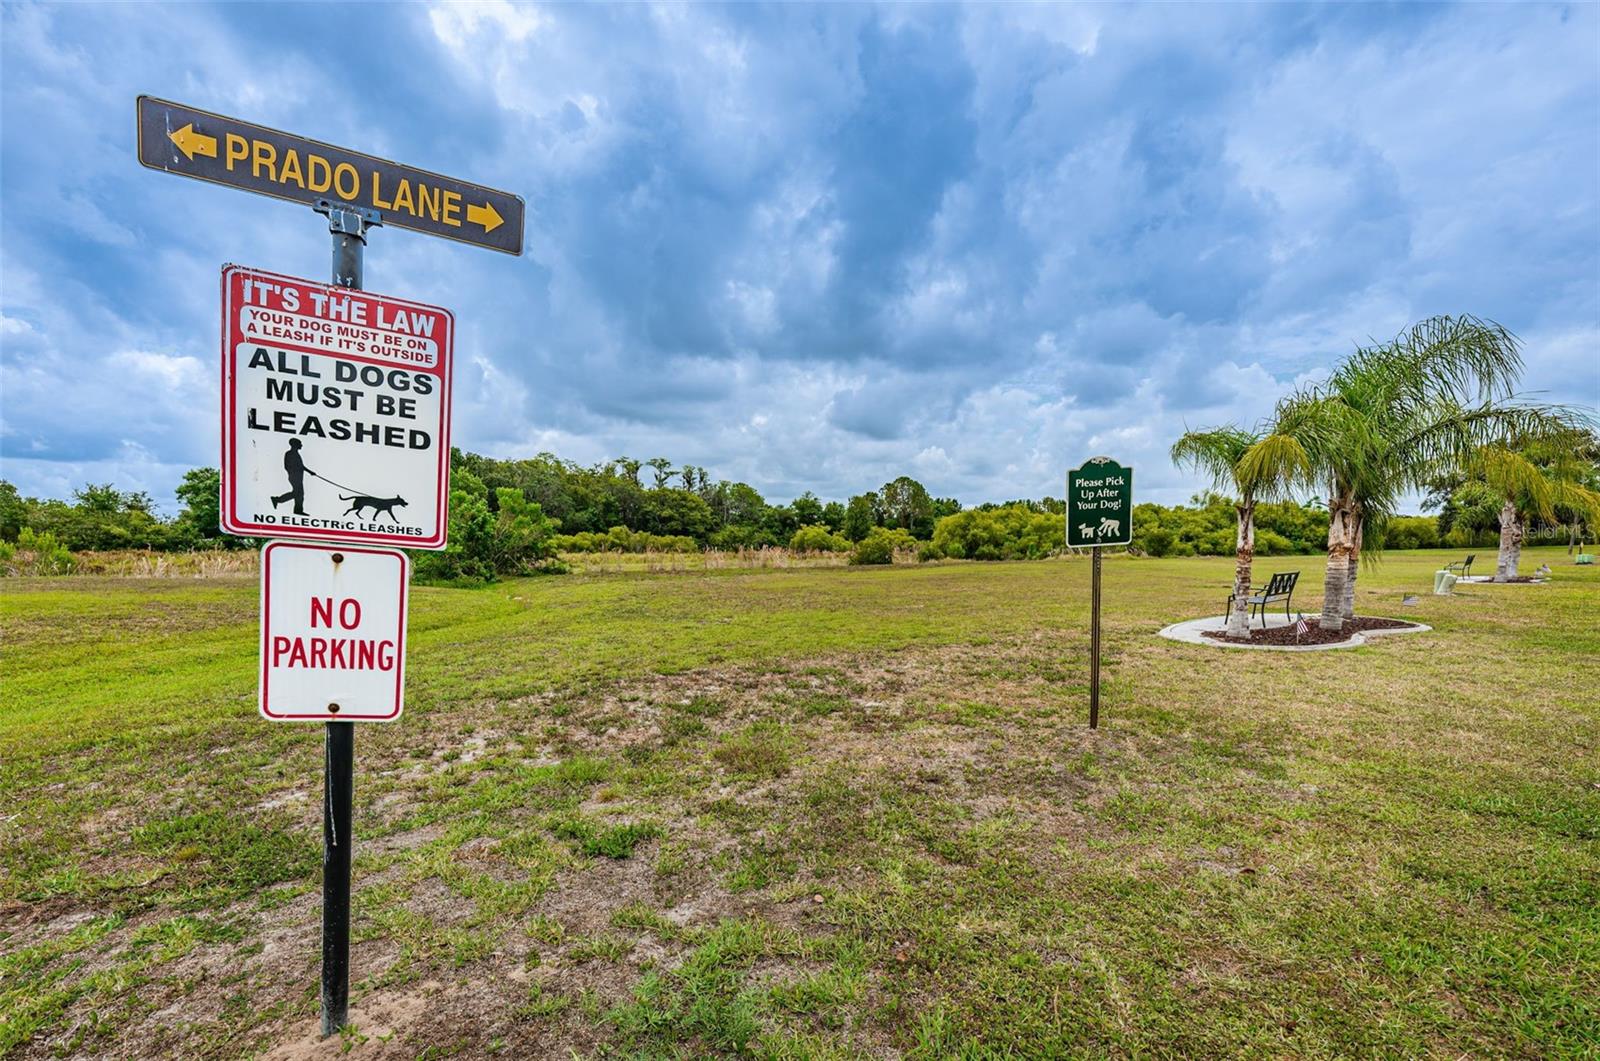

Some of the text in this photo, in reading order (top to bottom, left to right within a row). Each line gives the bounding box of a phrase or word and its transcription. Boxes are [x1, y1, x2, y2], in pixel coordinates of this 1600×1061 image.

[226, 133, 463, 227] PRADO LANE
[242, 279, 437, 337] IT'S THE LAW
[247, 322, 434, 364] A LEASH IF IT'S OUTSIDE
[250, 309, 428, 351] YOUR DOG MUST BE ON
[248, 347, 434, 396] ALL DOGS
[266, 377, 417, 420] MUST BE
[247, 407, 432, 451] LEASHED
[1075, 476, 1124, 487] Please Pick
[1081, 488, 1118, 500] Up After
[253, 513, 277, 525] NO
[359, 522, 424, 537] LEASHES
[1077, 499, 1122, 511] Your Dog!
[310, 596, 362, 630] NO
[272, 636, 395, 672] PARKING
